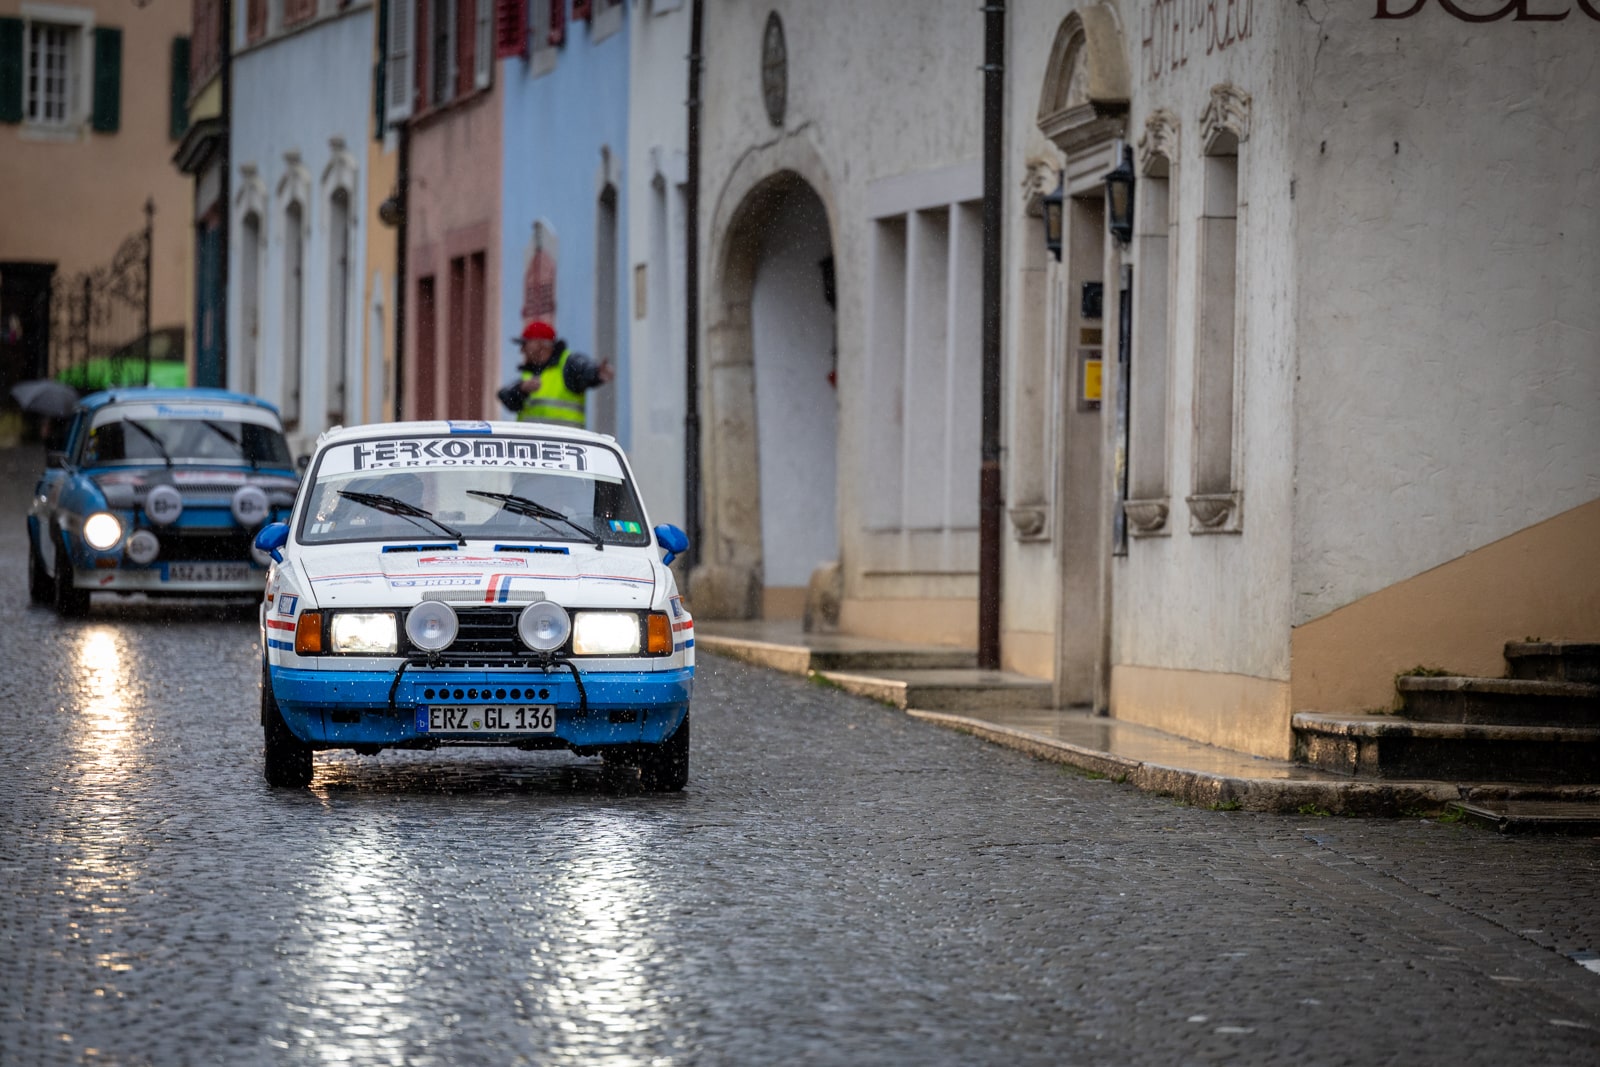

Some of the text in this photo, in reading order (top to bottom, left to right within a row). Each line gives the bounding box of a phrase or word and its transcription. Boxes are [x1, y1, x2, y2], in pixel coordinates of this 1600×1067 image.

[353, 440, 588, 471] HERKOMMER
[370, 459, 571, 469] PERFORMANCE
[430, 708, 552, 729] ERZ GL 136
